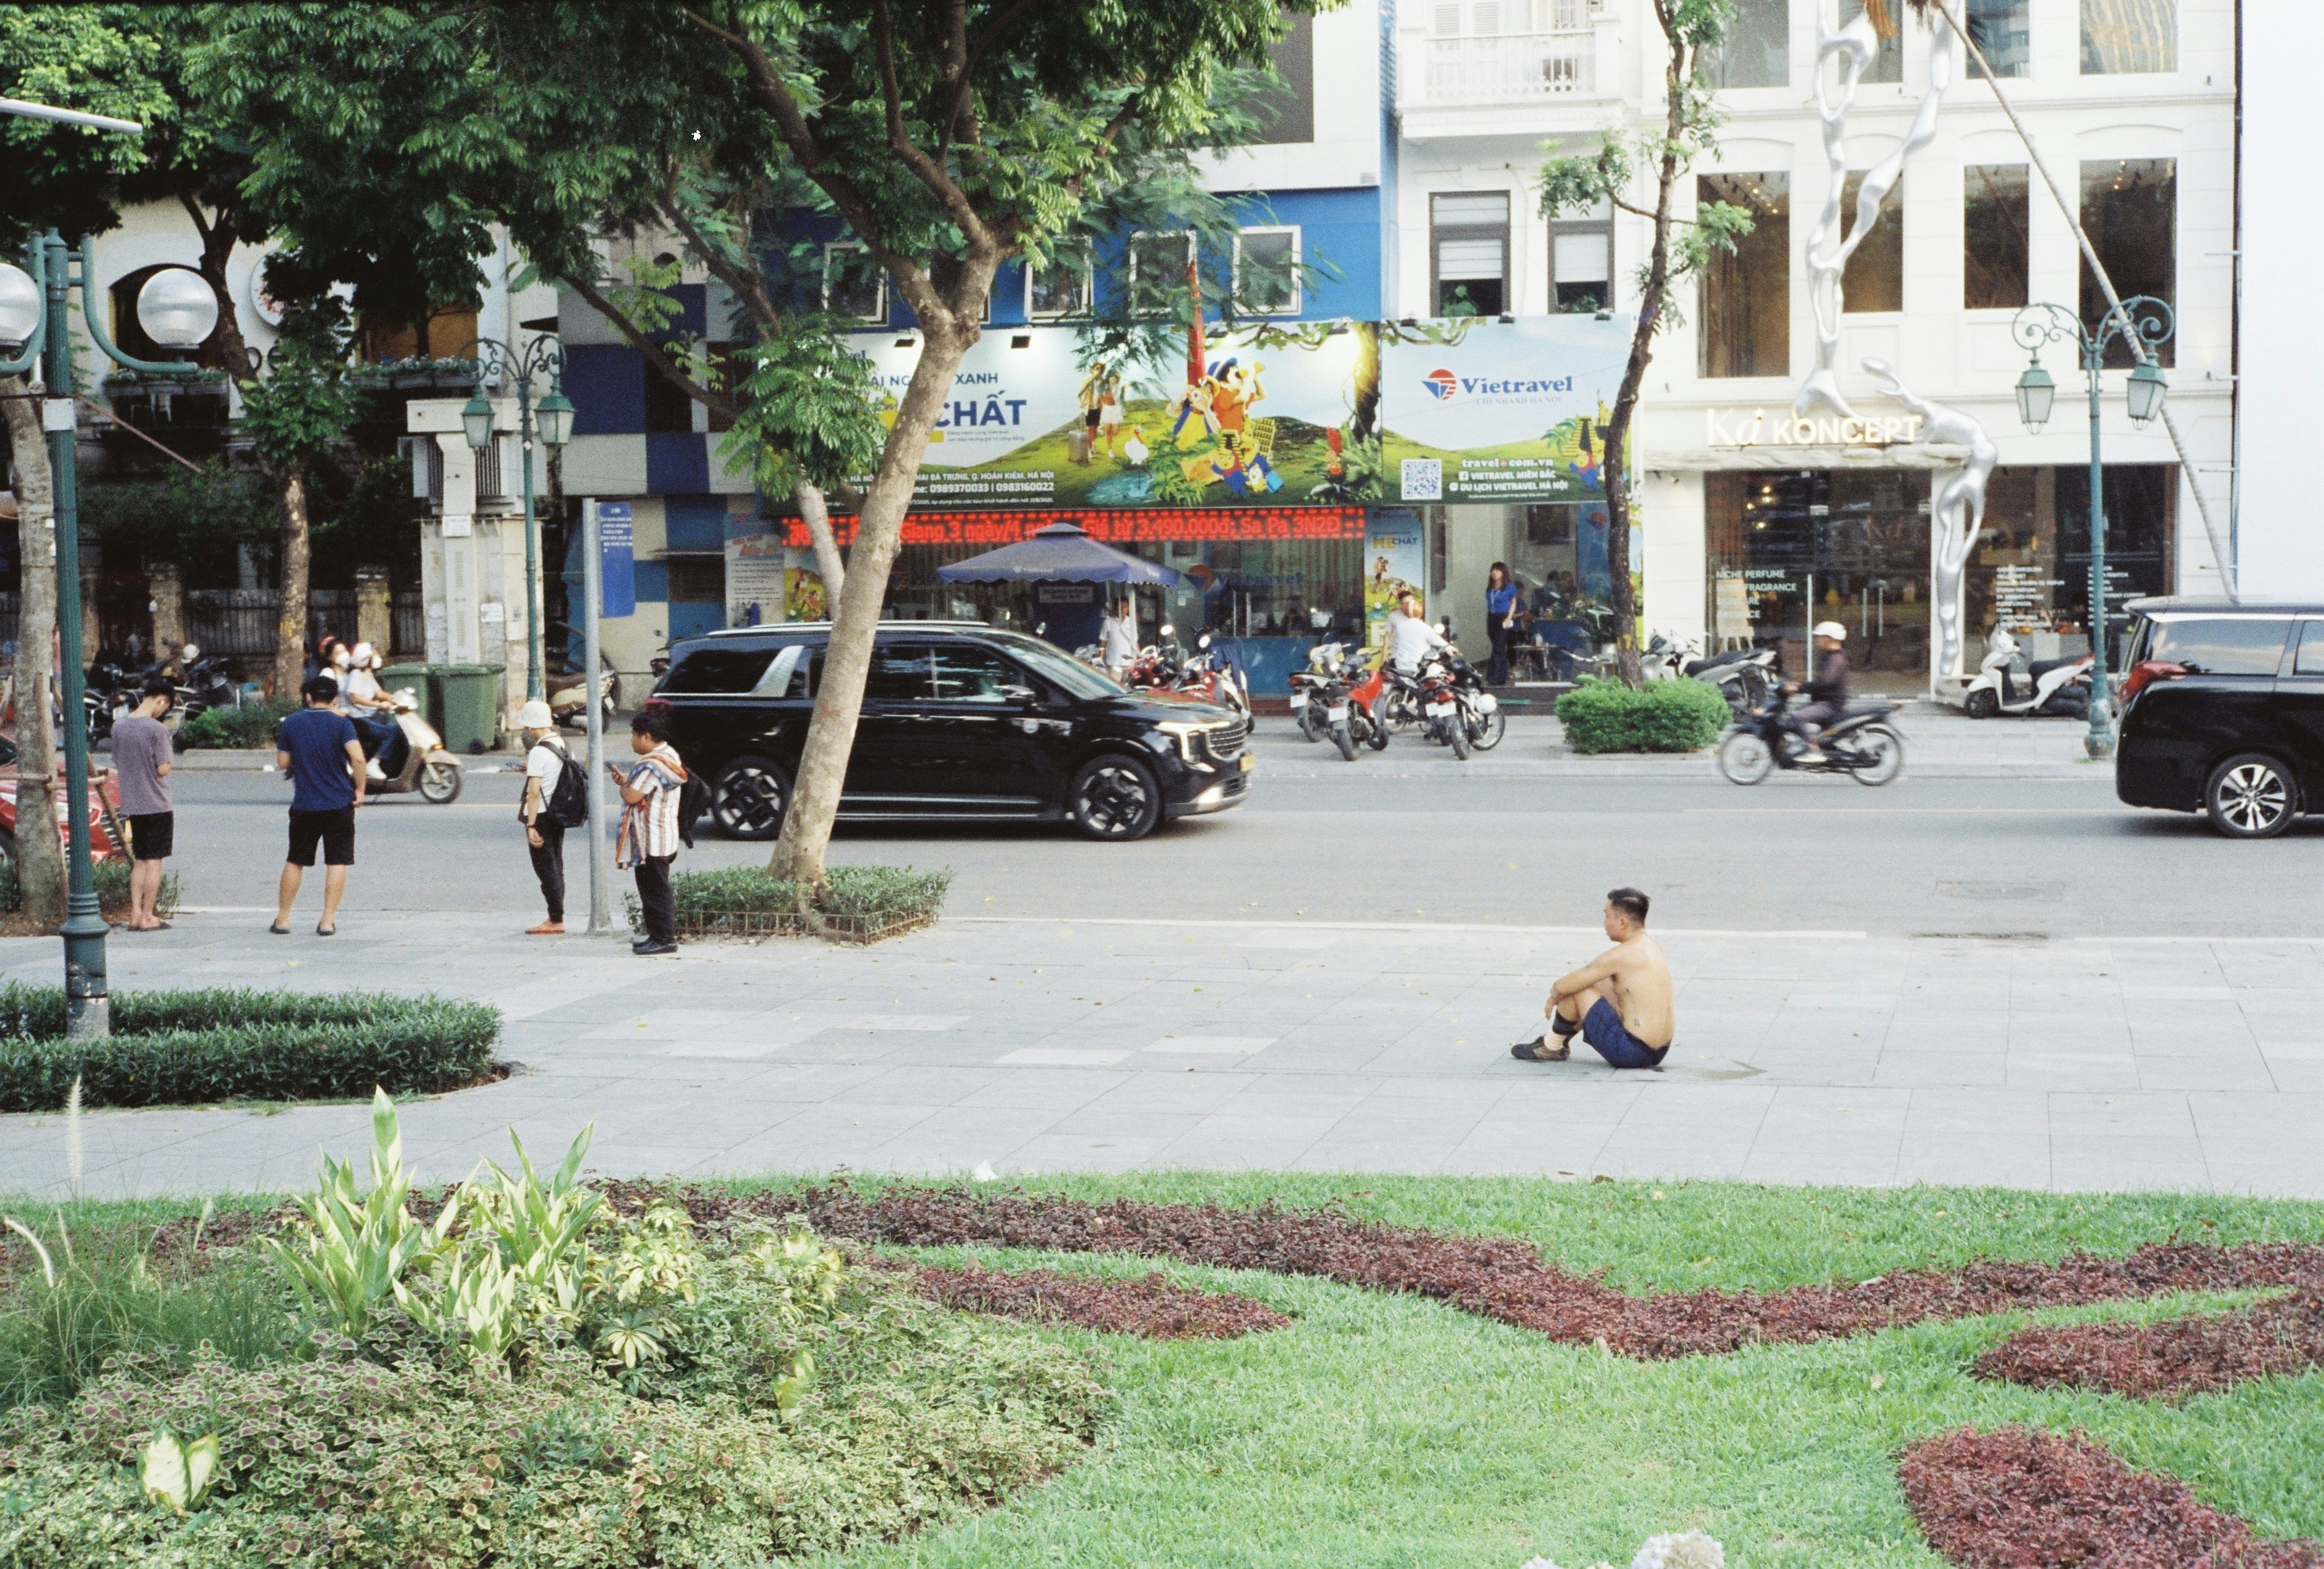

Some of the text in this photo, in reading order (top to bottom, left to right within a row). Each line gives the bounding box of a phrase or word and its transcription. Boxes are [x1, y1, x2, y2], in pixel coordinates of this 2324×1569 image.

[955, 373, 999, 385] XANH
[1461, 376, 1573, 394] Vietravel
[1773, 415, 1921, 445] KONCEPT
[1471, 471, 1515, 480] VIETRAVEL
[930, 483, 989, 493] 0989370033
[996, 482, 1054, 492] 0983160022
[1460, 483, 1472, 491] DU
[1494, 482, 1537, 491] VIETRAVEL
[1539, 480, 1551, 490] HÀ
[1553, 479, 1568, 491] NỘI
[902, 521, 944, 541] Giang
[949, 521, 960, 538] 3
[1240, 517, 1262, 534] Sa
[1268, 517, 1289, 534] Pa
[1716, 569, 1785, 578] NICHE PERFUME
[1744, 583, 1797, 592] FRAGRANCE
